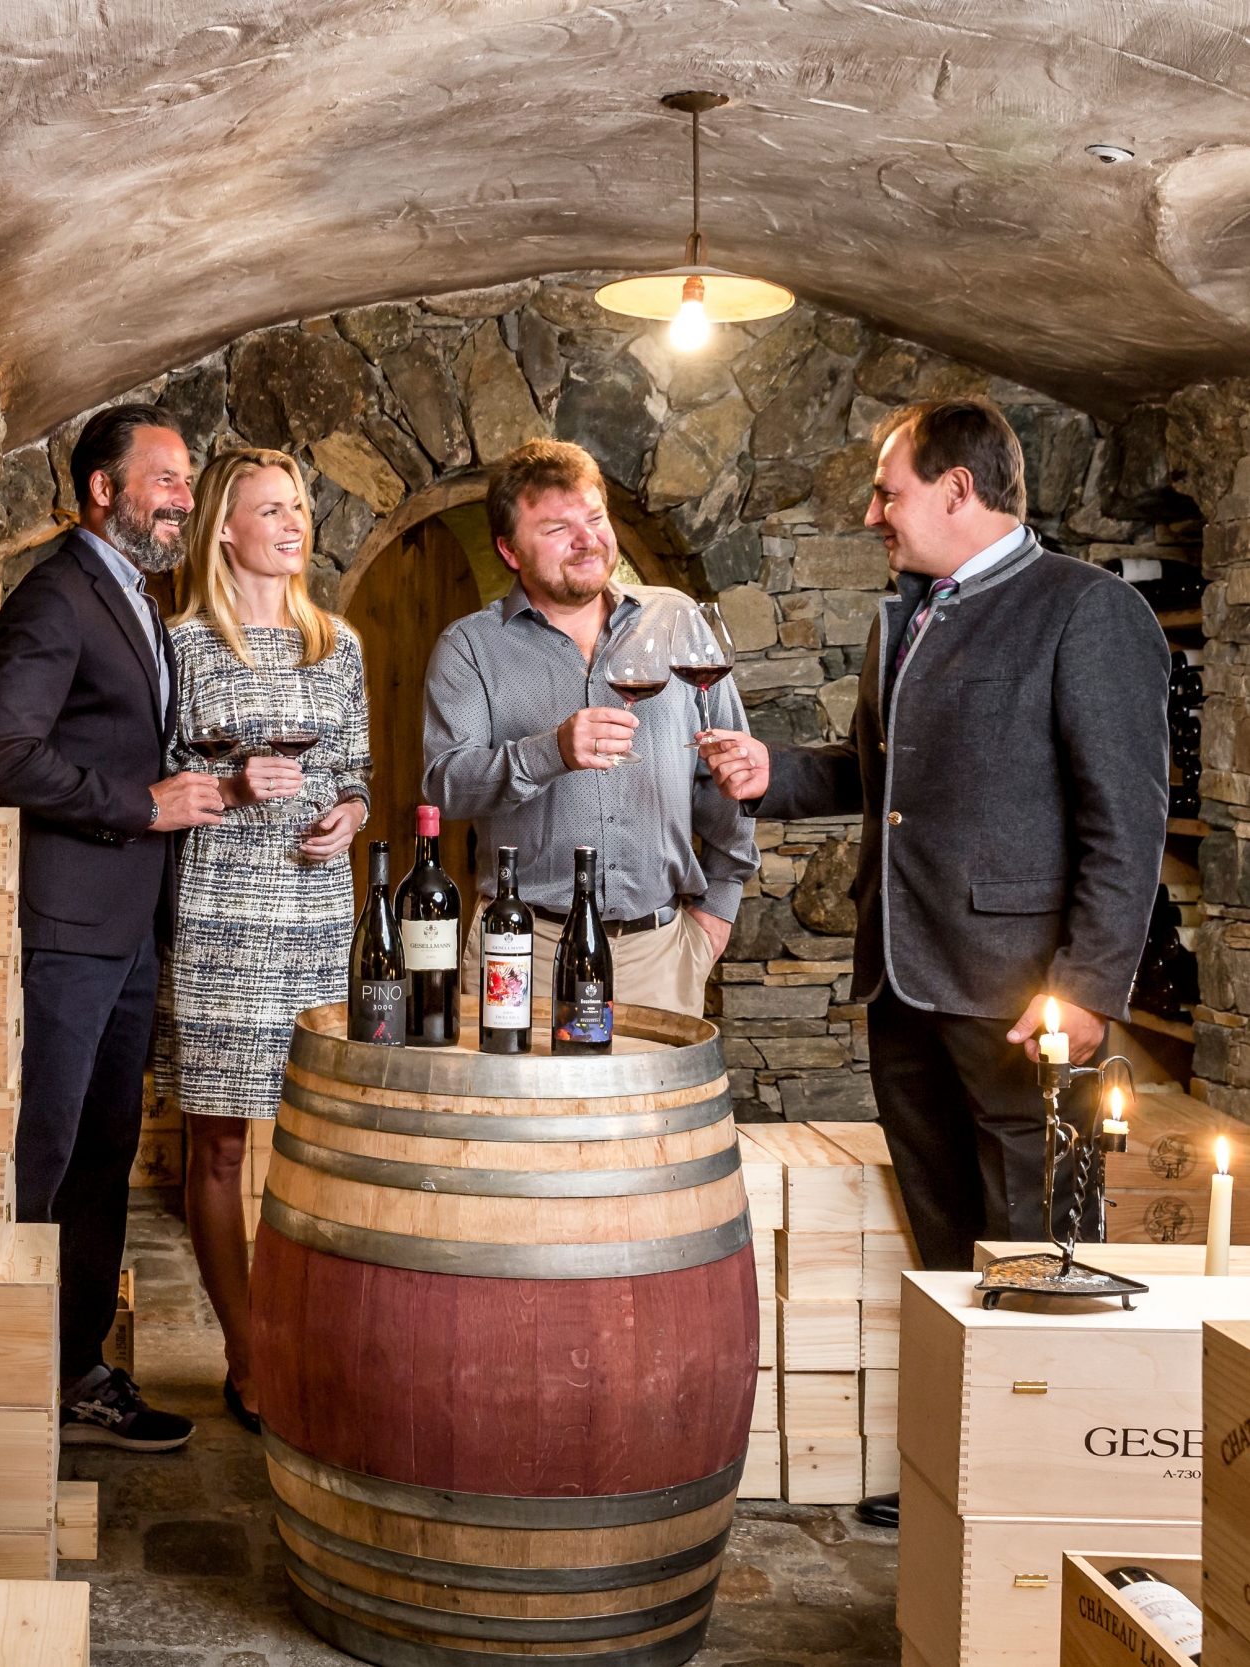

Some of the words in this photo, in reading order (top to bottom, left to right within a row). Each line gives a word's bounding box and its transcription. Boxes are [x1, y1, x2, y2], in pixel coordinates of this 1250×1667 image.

[362, 985, 402, 1001] PINO
[1084, 1426, 1203, 1458] GESE
[1162, 1469, 1201, 1479] A-730
[1078, 1595, 1137, 1653] CHÂTEAU
